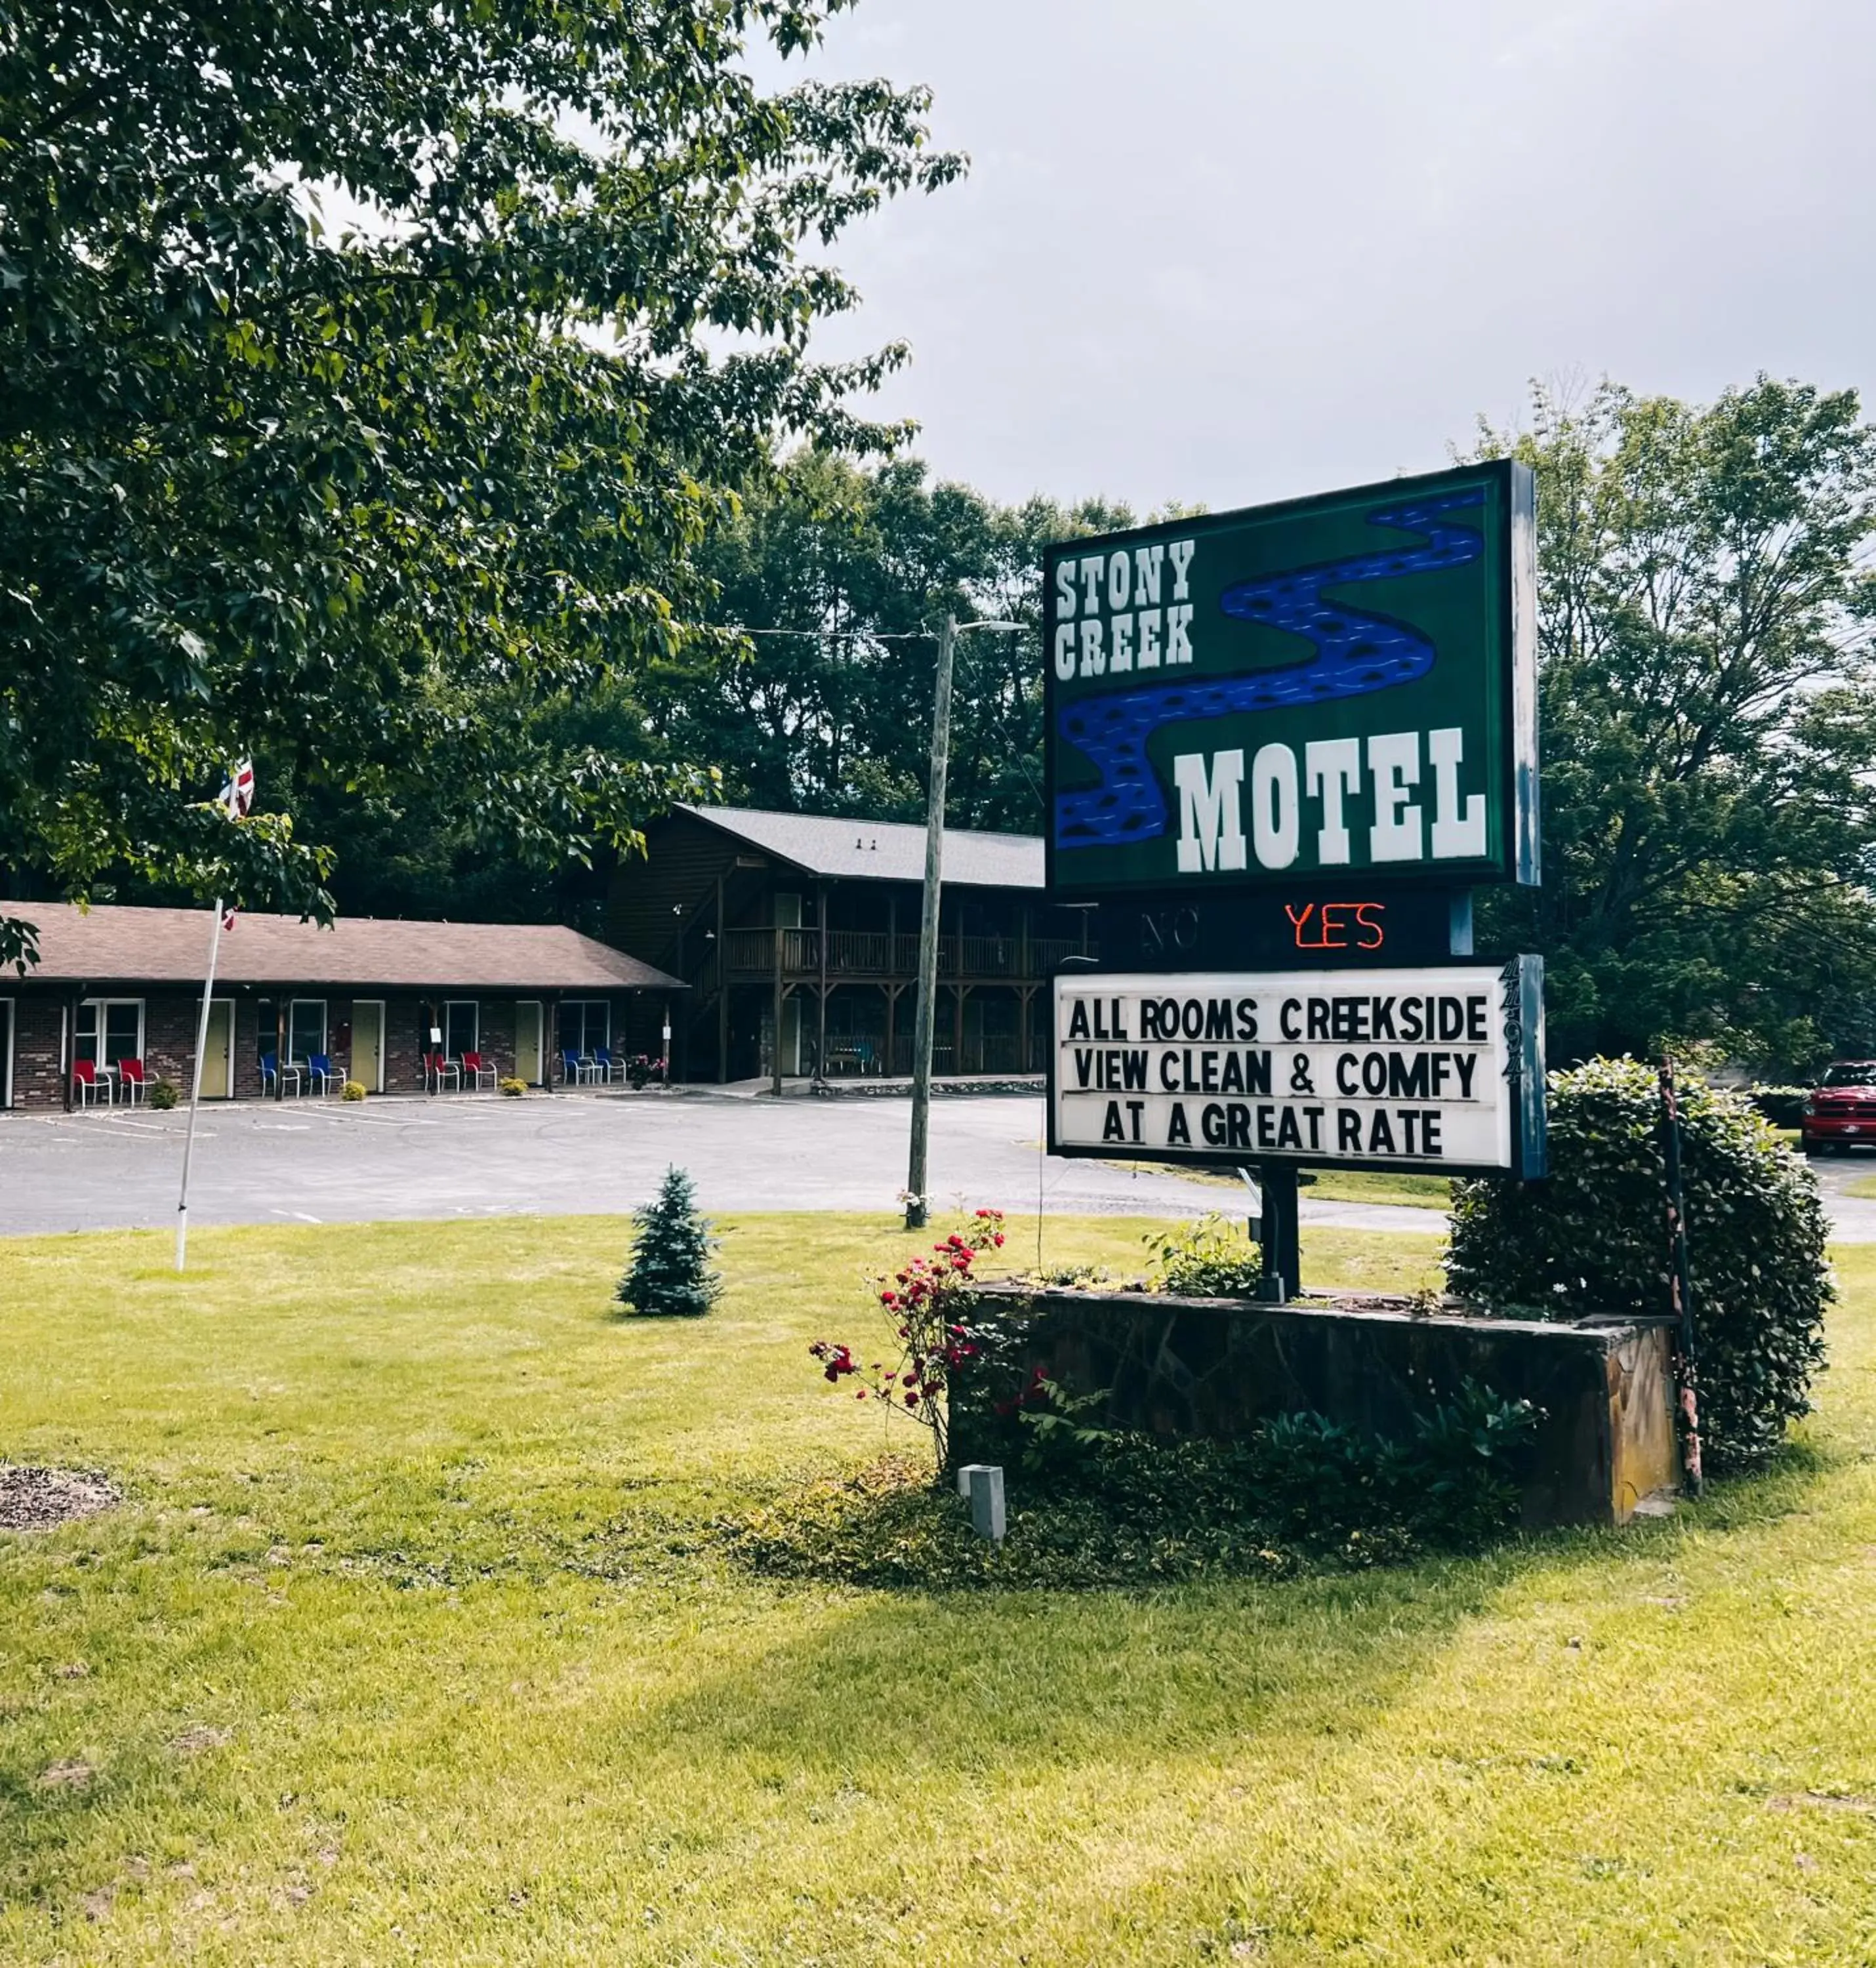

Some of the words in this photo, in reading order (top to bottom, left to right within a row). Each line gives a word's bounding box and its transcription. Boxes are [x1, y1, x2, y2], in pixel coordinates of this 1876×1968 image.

[1057, 540, 1195, 619] STONY
[1055, 604, 1194, 680] CREEK
[1173, 727, 1487, 872] MOTEL
[1285, 903, 1385, 949] YES
[1069, 998, 1128, 1040] ALL
[1140, 998, 1258, 1040] ROOMS
[1280, 996, 1488, 1041] CREEKSIDE
[1074, 1048, 1149, 1090] VIEW
[1160, 1050, 1271, 1094] CLEAN
[1290, 1052, 1315, 1092] &
[1336, 1052, 1477, 1097] COMFY
[1103, 1101, 1145, 1141] AT
[1167, 1103, 1191, 1143] A
[1201, 1103, 1325, 1151] GREAT
[1337, 1108, 1443, 1155] RATE
